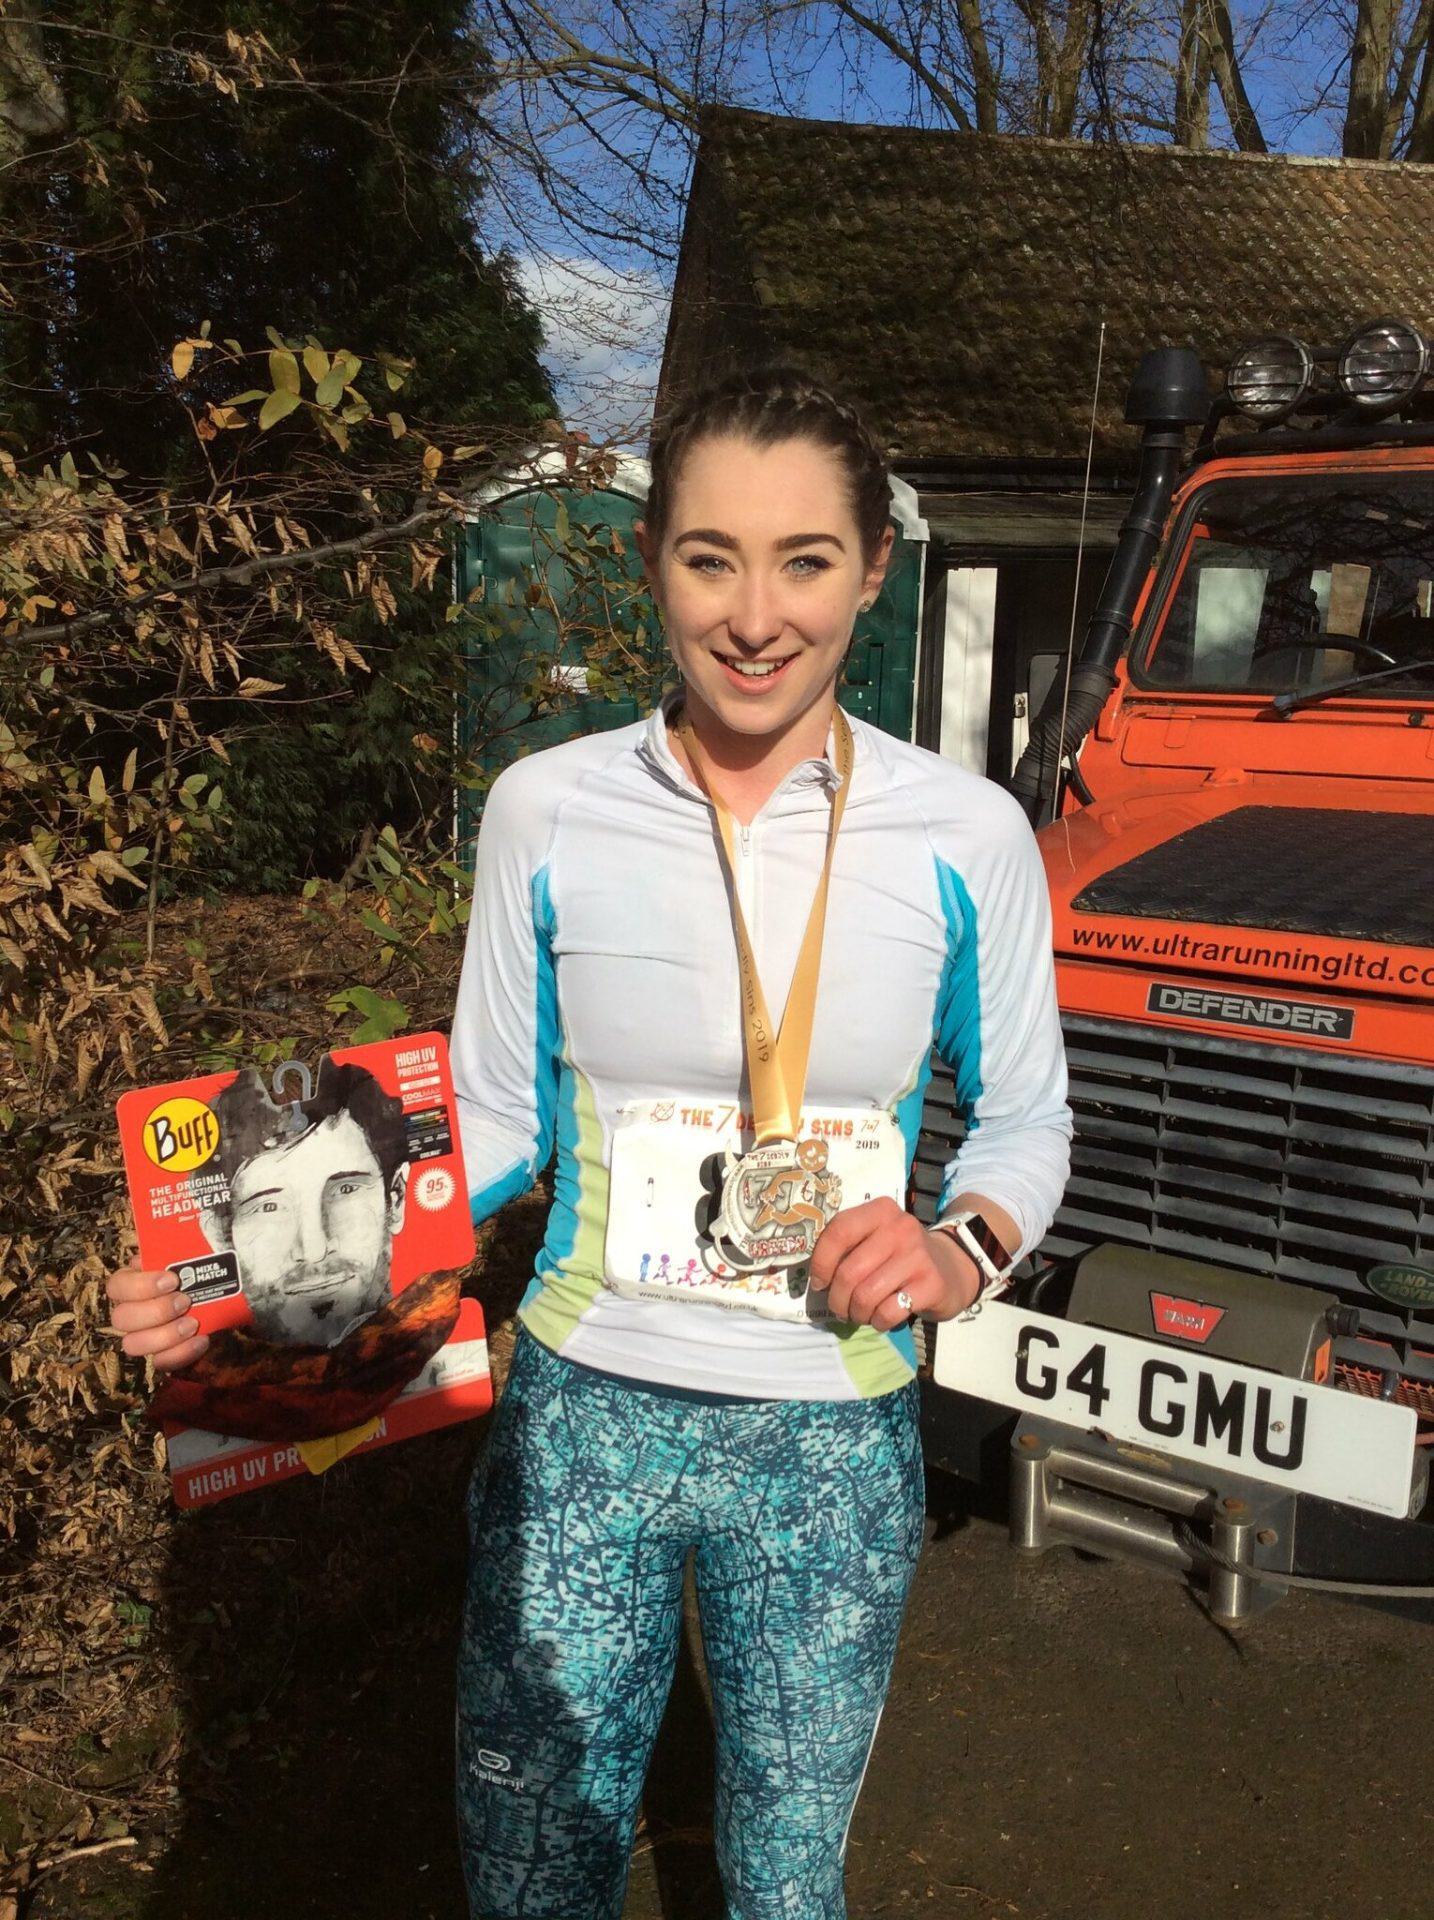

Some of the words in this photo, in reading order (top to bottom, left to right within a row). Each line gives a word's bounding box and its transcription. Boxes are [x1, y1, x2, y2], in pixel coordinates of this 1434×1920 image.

[1159, 988, 1343, 1032] DEFENDER
[753, 1019, 769, 1062] 2019
[395, 1049, 420, 1068] HIGH
[421, 1046, 436, 1062] UV
[397, 1061, 439, 1078] PROTECTION
[681, 1109, 713, 1126] THE
[716, 1105, 736, 1133] 7
[811, 1118, 853, 1137] SINS
[856, 1140, 879, 1150] 2019
[149, 1185, 172, 1198] THE
[176, 1172, 228, 1192] ORIGINAL
[151, 1183, 230, 1206] MULTIFUNCTIONAL
[152, 1191, 231, 1219] HEADWEAR
[197, 1268, 228, 1282] MATCH
[1385, 1270, 1426, 1287] LAND
[1015, 1325, 1110, 1417] G4
[1138, 1359, 1308, 1471] GMU
[188, 1466, 237, 1499] HIGH
[242, 1456, 267, 1481] UV
